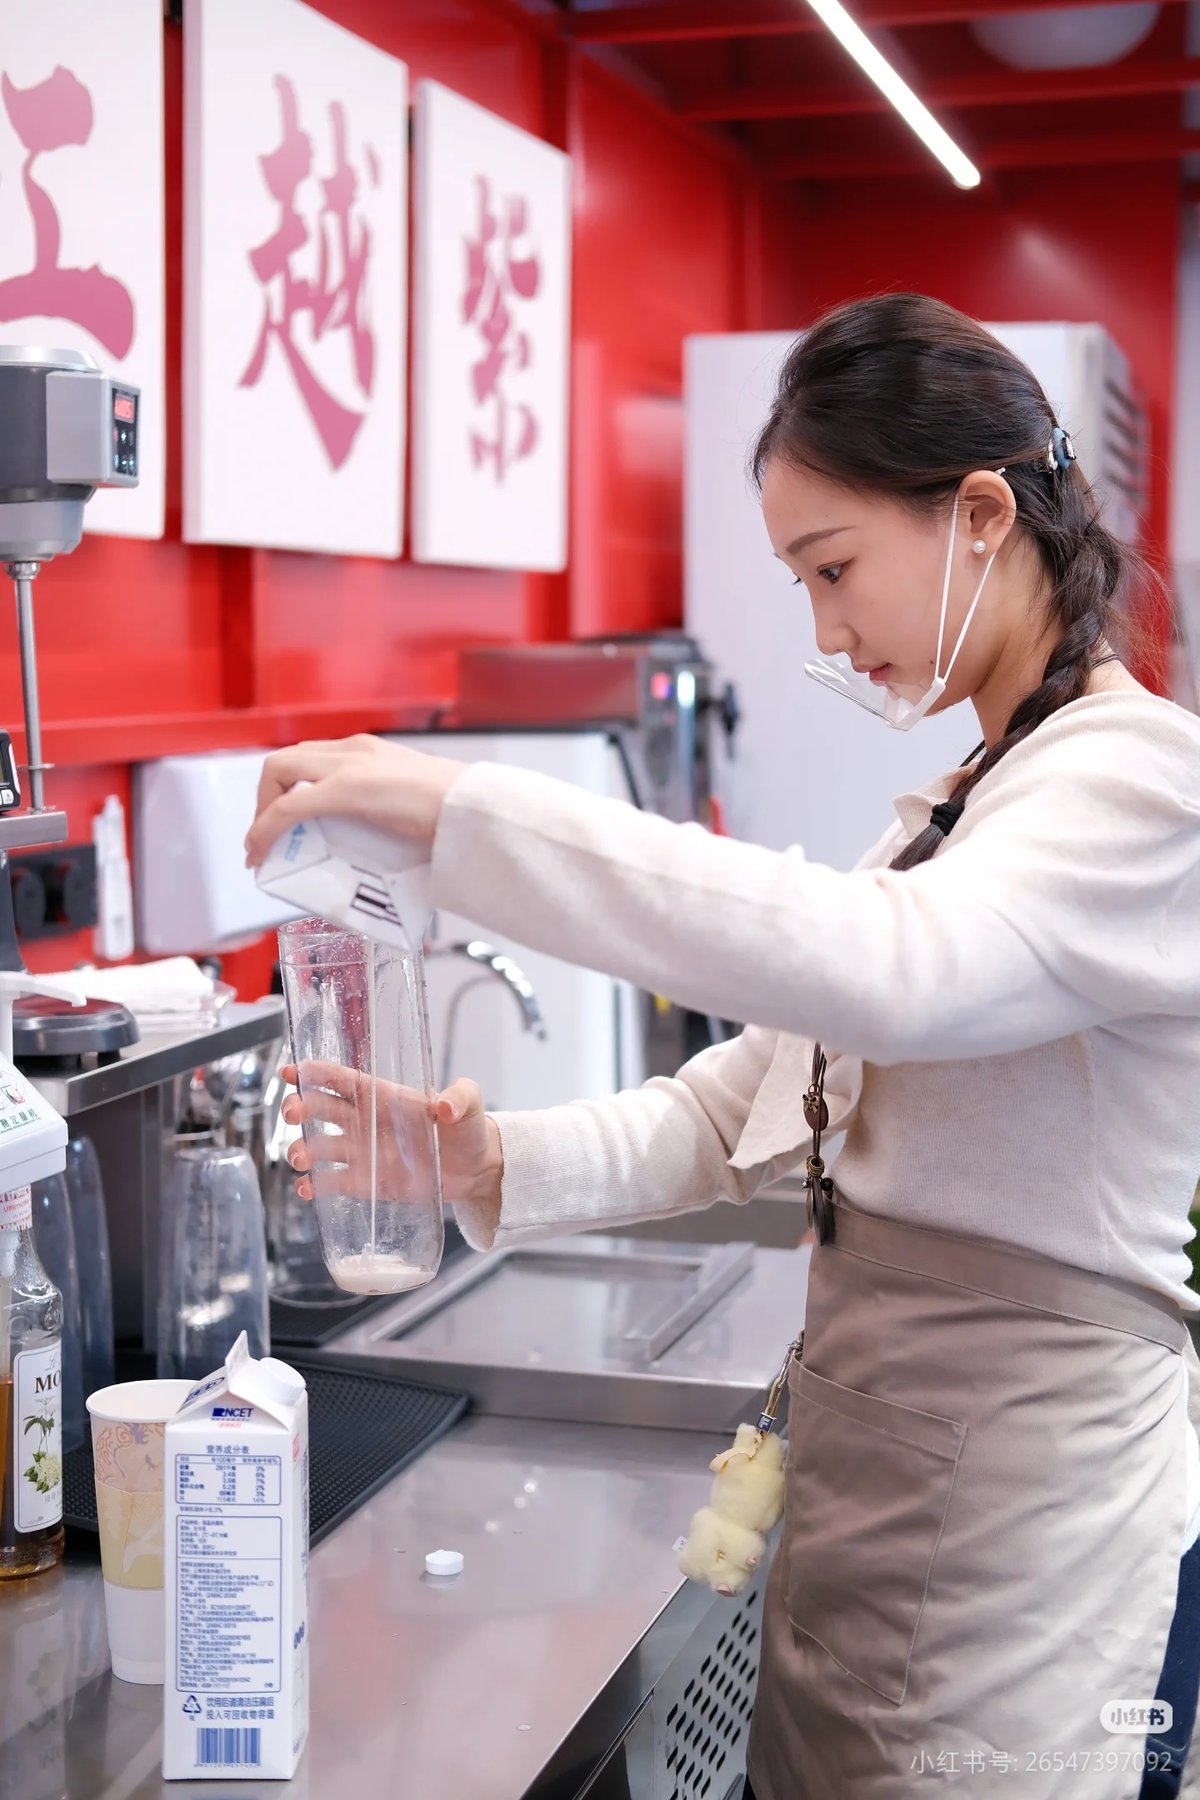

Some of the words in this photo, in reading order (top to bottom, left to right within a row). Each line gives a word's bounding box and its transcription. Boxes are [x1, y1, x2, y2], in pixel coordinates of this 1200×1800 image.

[236, 73, 382, 474] 越
[206, 1444, 250, 1455] 营养成分表
[206, 1709, 274, 1720] 投入可回收物容器
